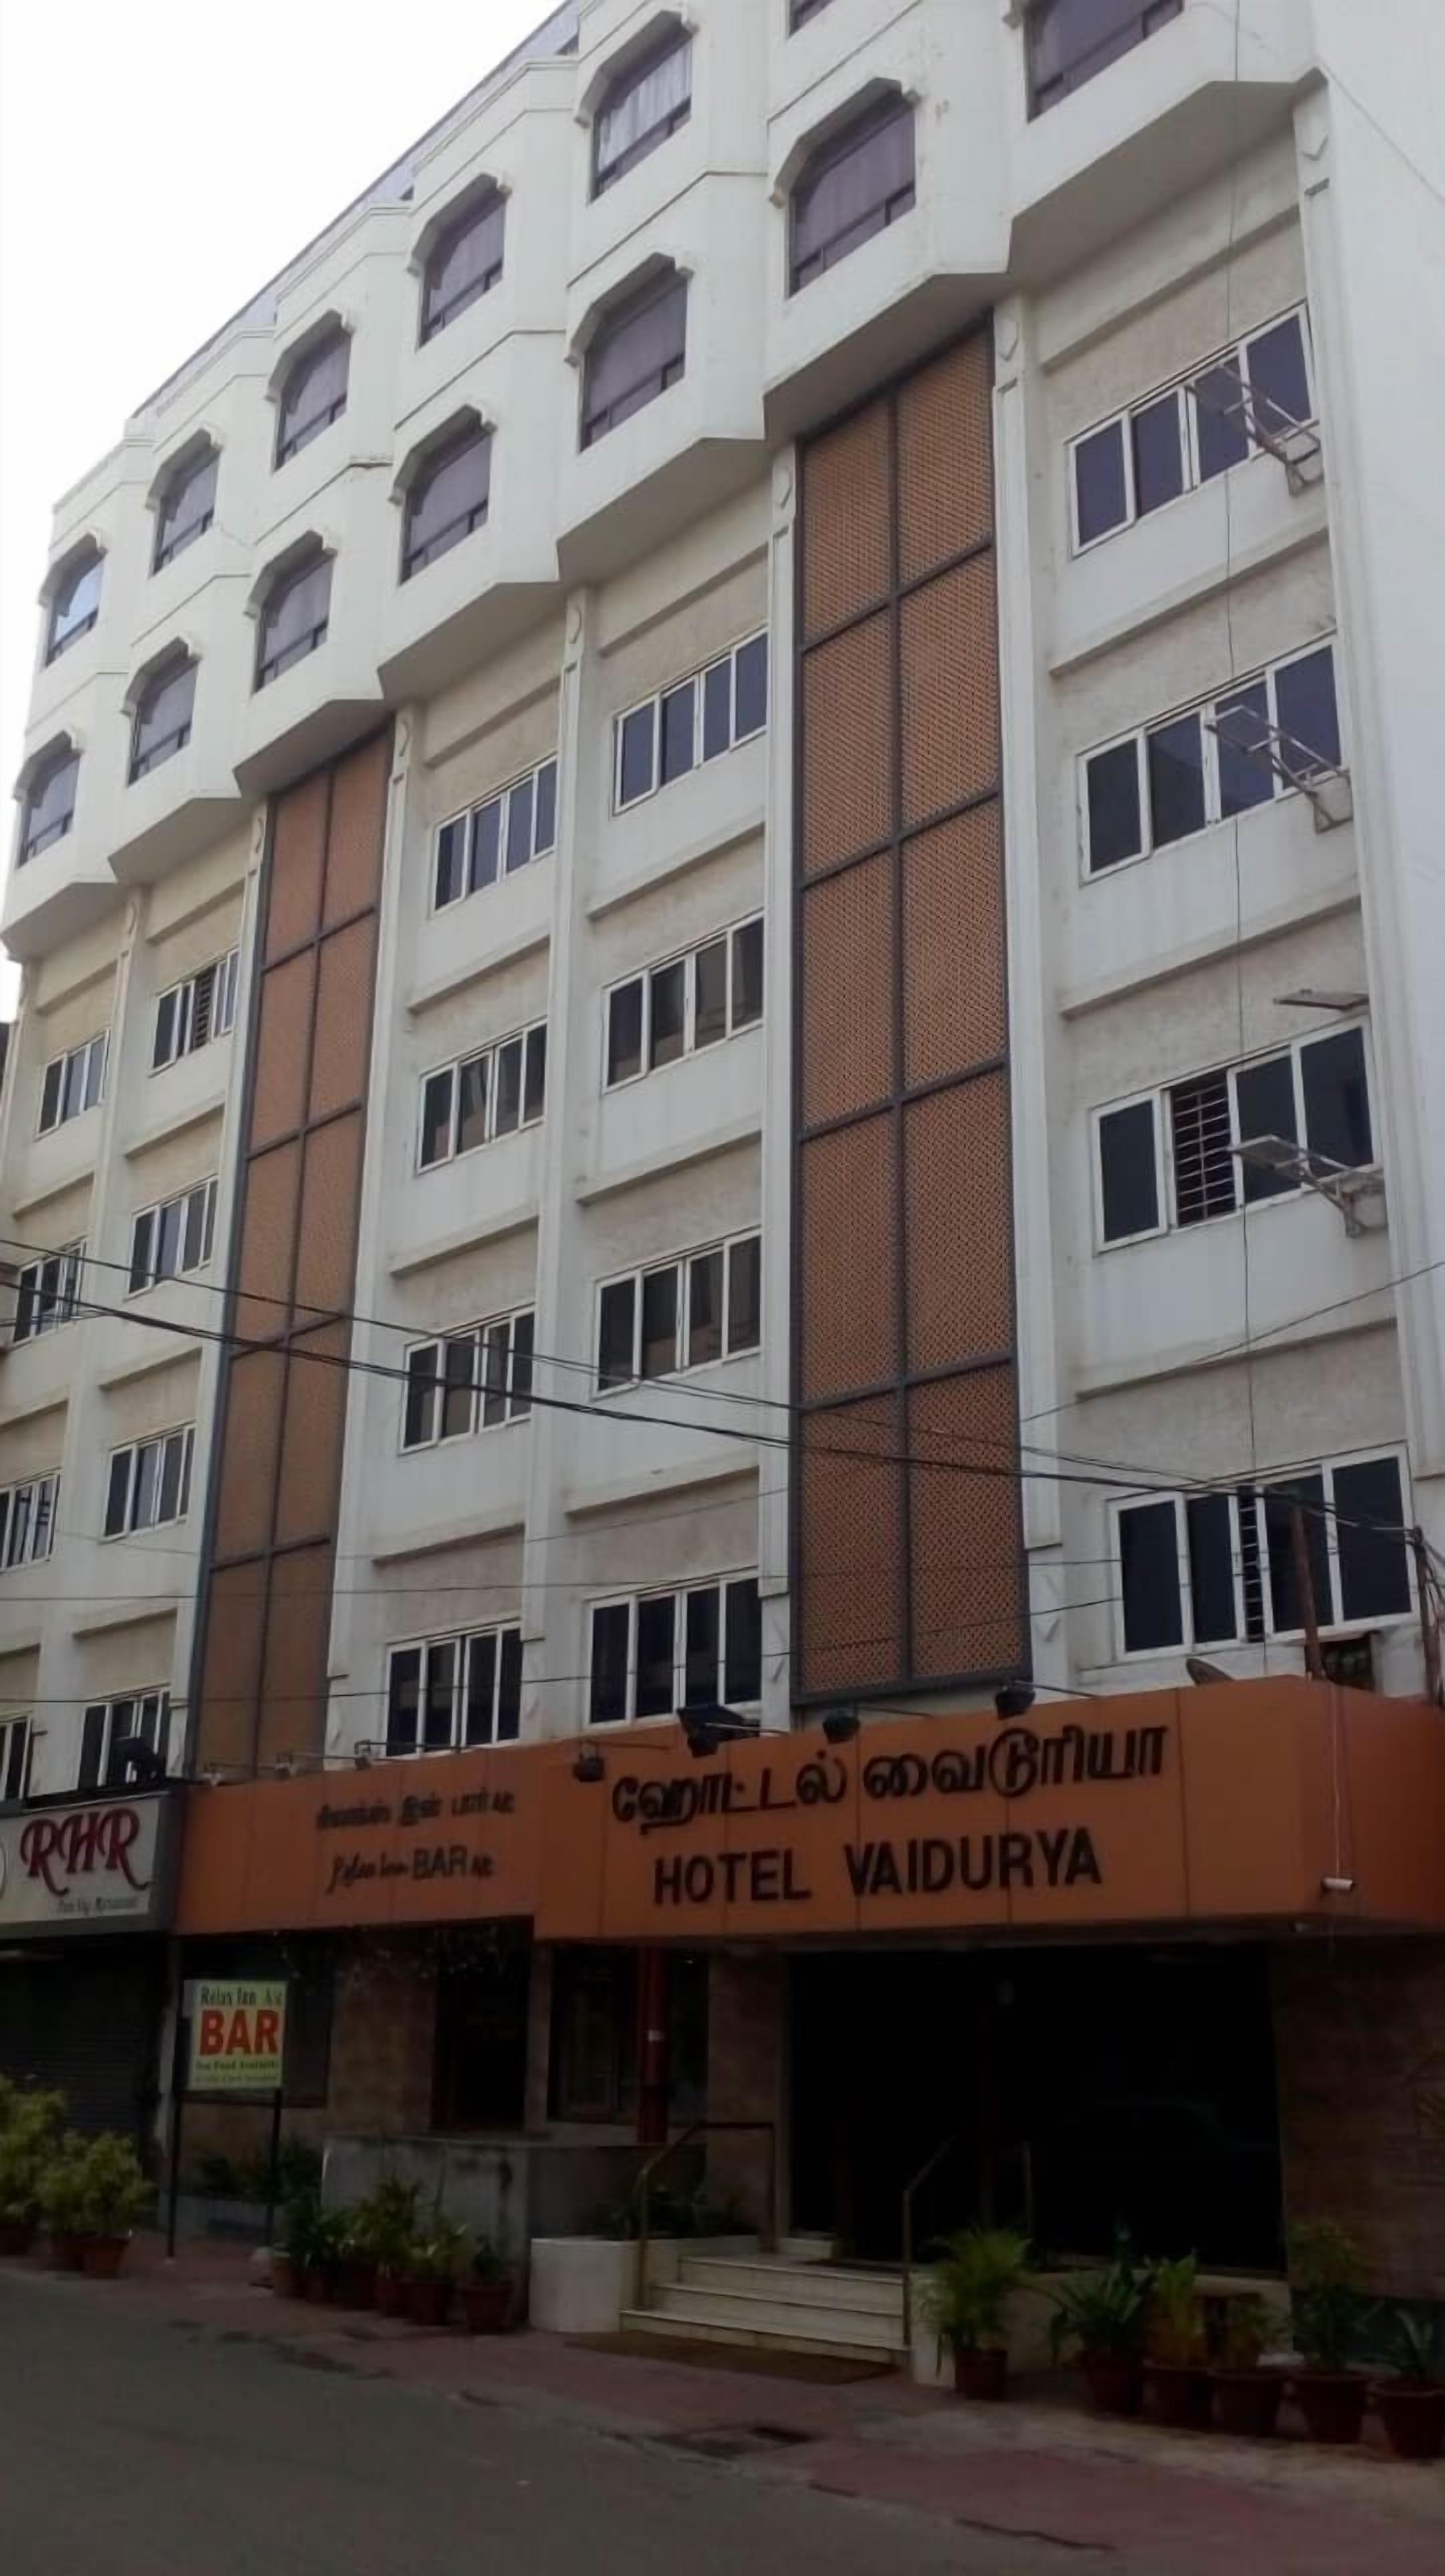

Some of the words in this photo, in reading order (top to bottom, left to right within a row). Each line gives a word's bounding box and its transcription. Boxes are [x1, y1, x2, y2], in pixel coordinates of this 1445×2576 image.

[20, 1808, 149, 1897] RHR
[412, 1845, 468, 1880] BAR
[655, 1847, 813, 1906] HOTEL
[844, 1826, 1103, 1897] VAIDURYA
[200, 2009, 279, 2056] BAR
